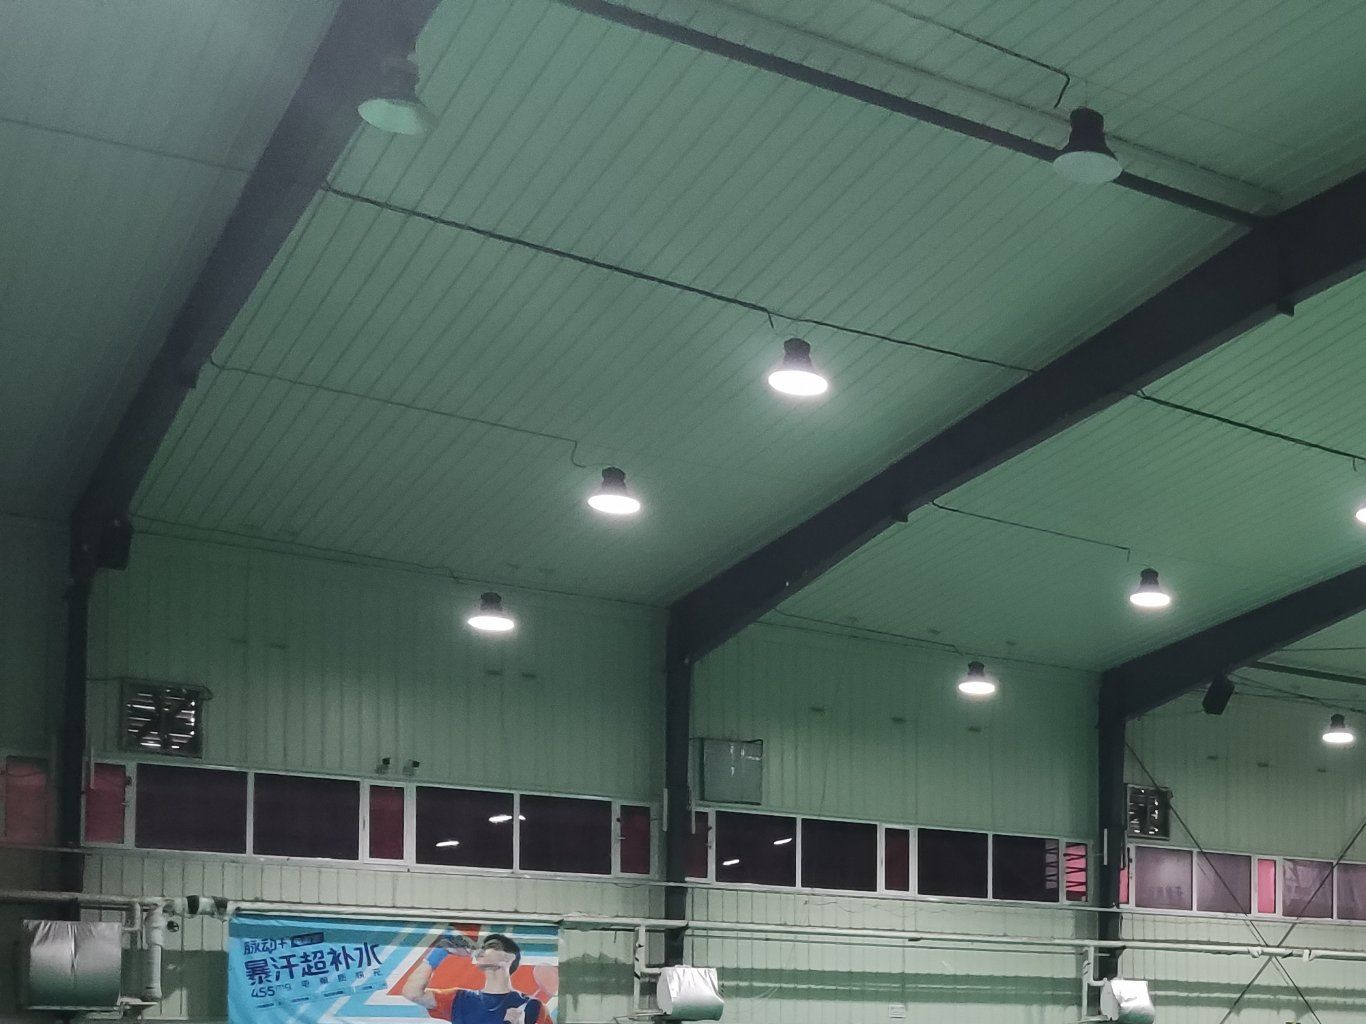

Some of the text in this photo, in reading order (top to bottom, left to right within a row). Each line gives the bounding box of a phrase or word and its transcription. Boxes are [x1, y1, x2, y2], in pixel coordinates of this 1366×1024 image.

[244, 942, 382, 986] 暴汗超补水
